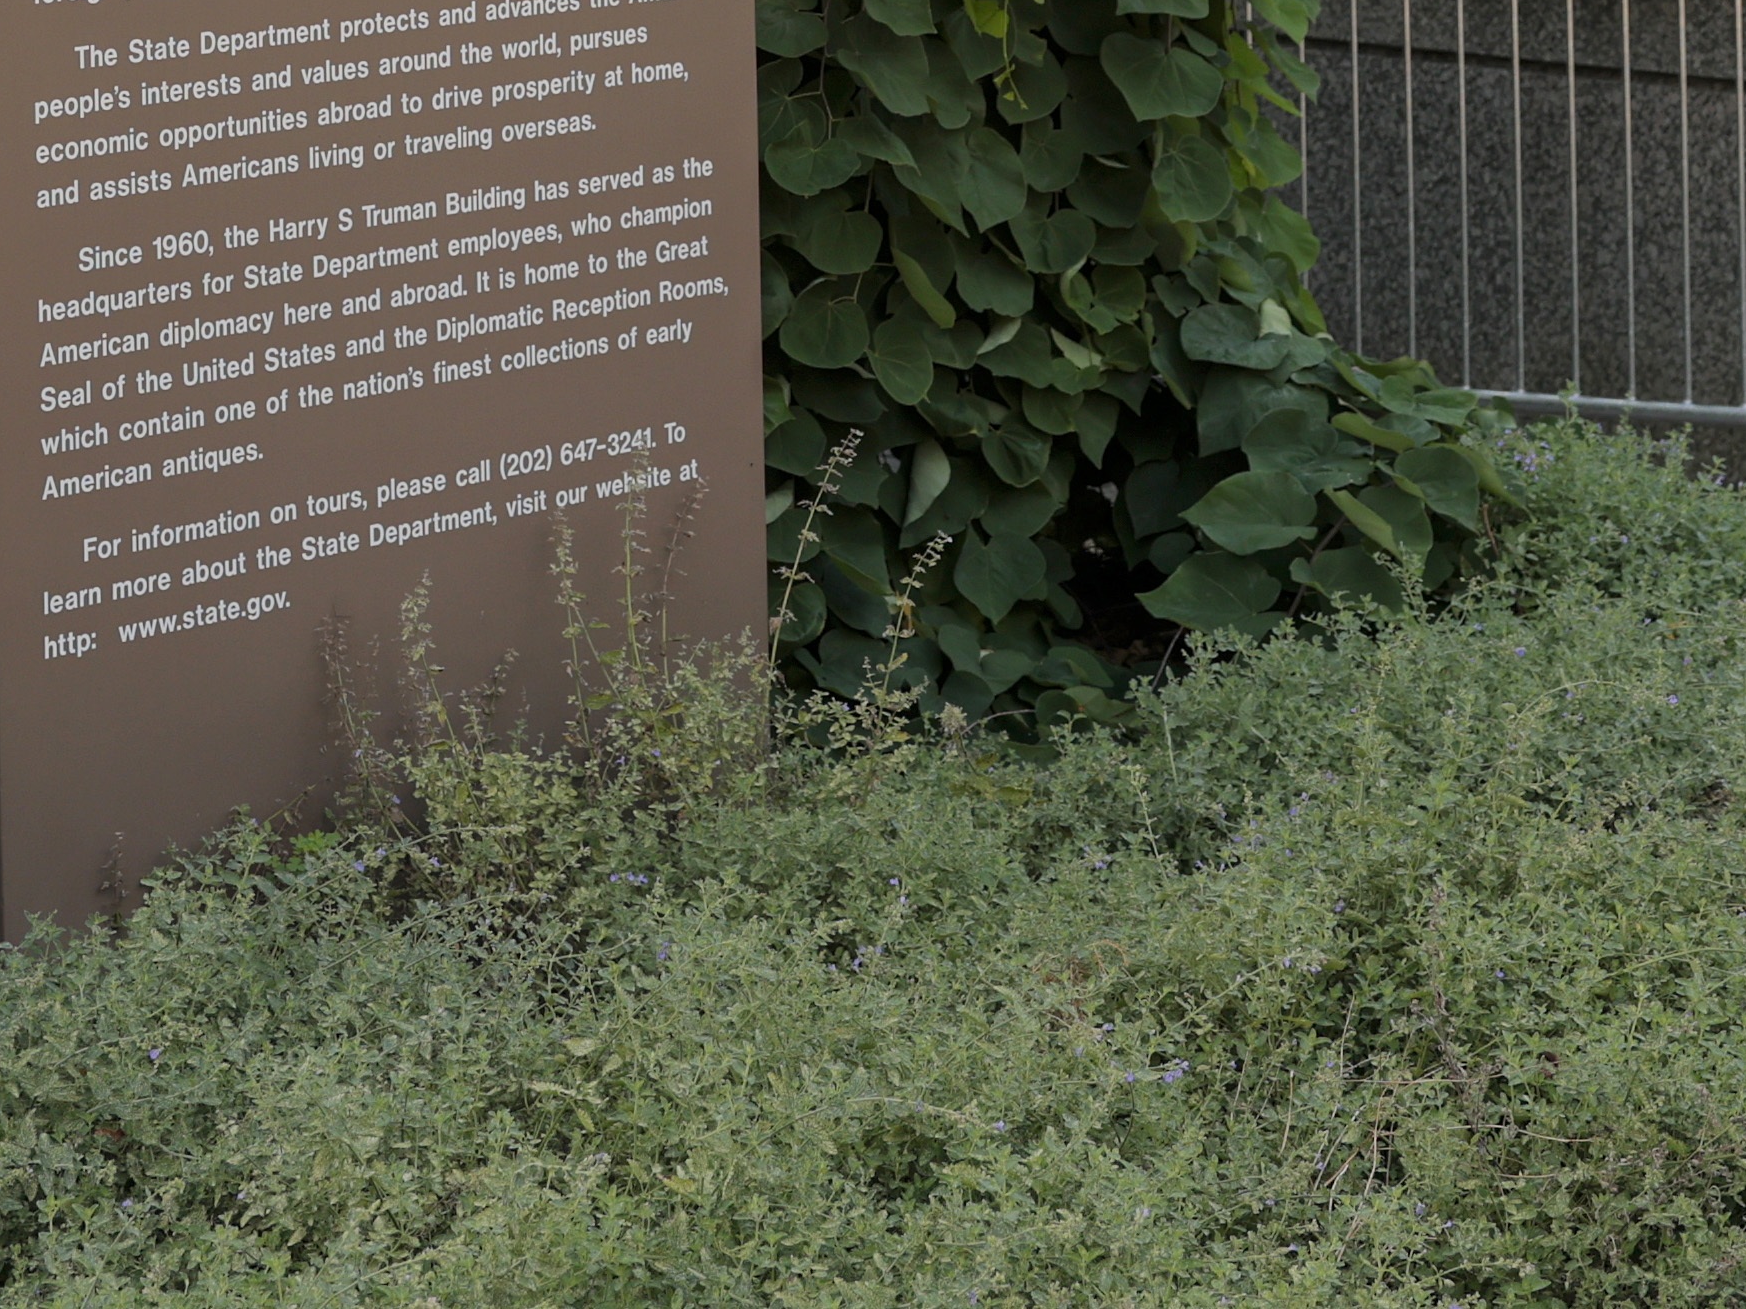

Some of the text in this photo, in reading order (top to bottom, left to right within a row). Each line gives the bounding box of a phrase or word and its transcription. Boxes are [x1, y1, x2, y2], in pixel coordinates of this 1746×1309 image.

[34, 26, 648, 125] people's interests and values around the world, pursues
[73, 44, 118, 70] The
[128, 36, 190, 64] State
[200, 18, 331, 57] Department
[340, 8, 430, 43] protects
[438, 0, 477, 27] and
[35, 61, 689, 164] economic opportunities abroad to drive prosperity at home,
[36, 114, 597, 209] and assists Americans living or traveling overseas.
[38, 197, 712, 323] headquarters for State Department employees, who champion
[78, 156, 714, 272] Since 1960, the Harry S Truman Building has served as the
[39, 235, 709, 368] American diplomacy here and abroad. It is home to the Great
[40, 276, 729, 412] Seal of the United States and the Diplomatic Reception Rooms,
[40, 318, 693, 456] which contain one of the nation's finest collections of early
[41, 442, 264, 501] American antiques.
[83, 421, 686, 563] For information on tours, please call (202) 647-3241. To
[43, 586, 102, 616] learn
[112, 572, 172, 601] more
[181, 551, 247, 586] about
[255, 545, 292, 570] the
[301, 531, 360, 561] State
[369, 501, 498, 547] Department,
[505, 489, 548, 518] visit
[555, 485, 588, 509] our
[679, 458, 699, 483] at
[44, 590, 291, 660] http: www.state.gov.
